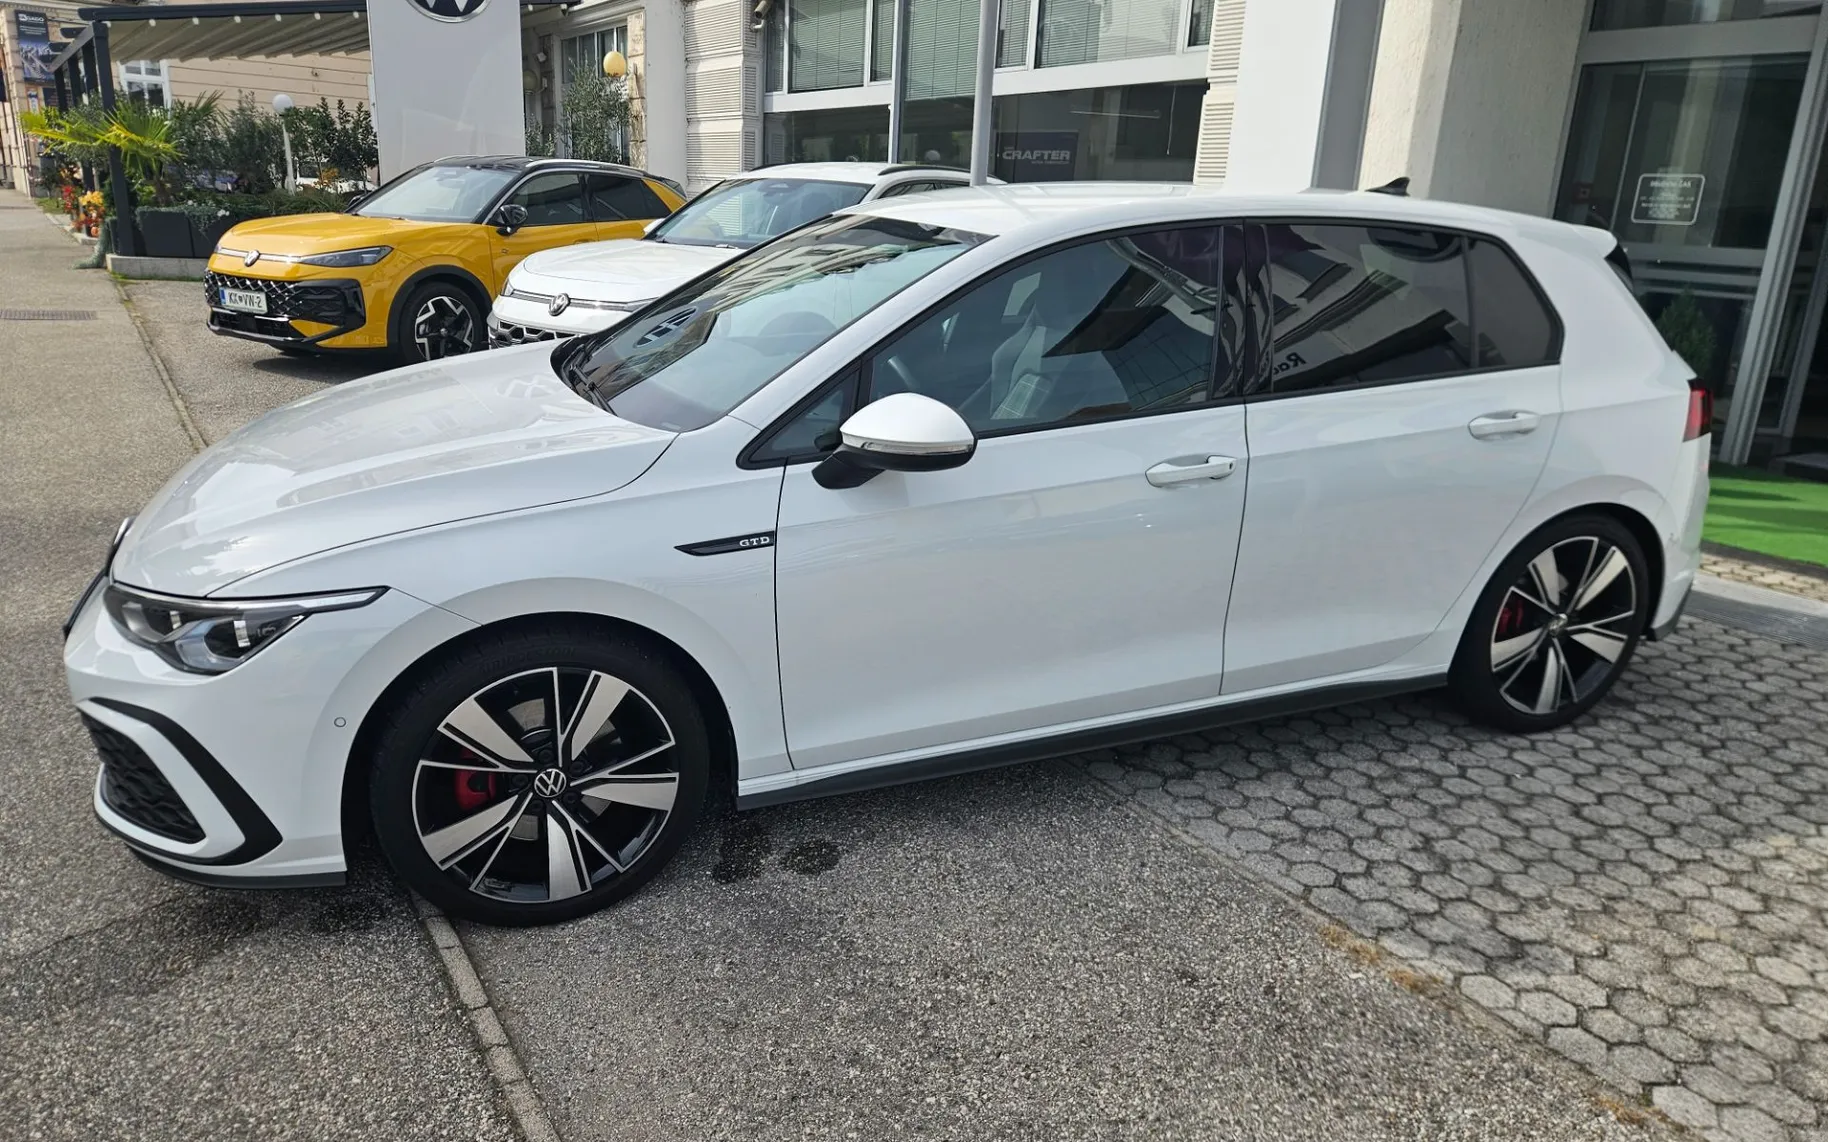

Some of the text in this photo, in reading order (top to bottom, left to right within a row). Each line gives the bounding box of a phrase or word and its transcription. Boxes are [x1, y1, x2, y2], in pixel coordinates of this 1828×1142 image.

[1002, 150, 1070, 160] CRAFTER
[228, 292, 239, 304] KK
[740, 536, 770, 547] GTD
